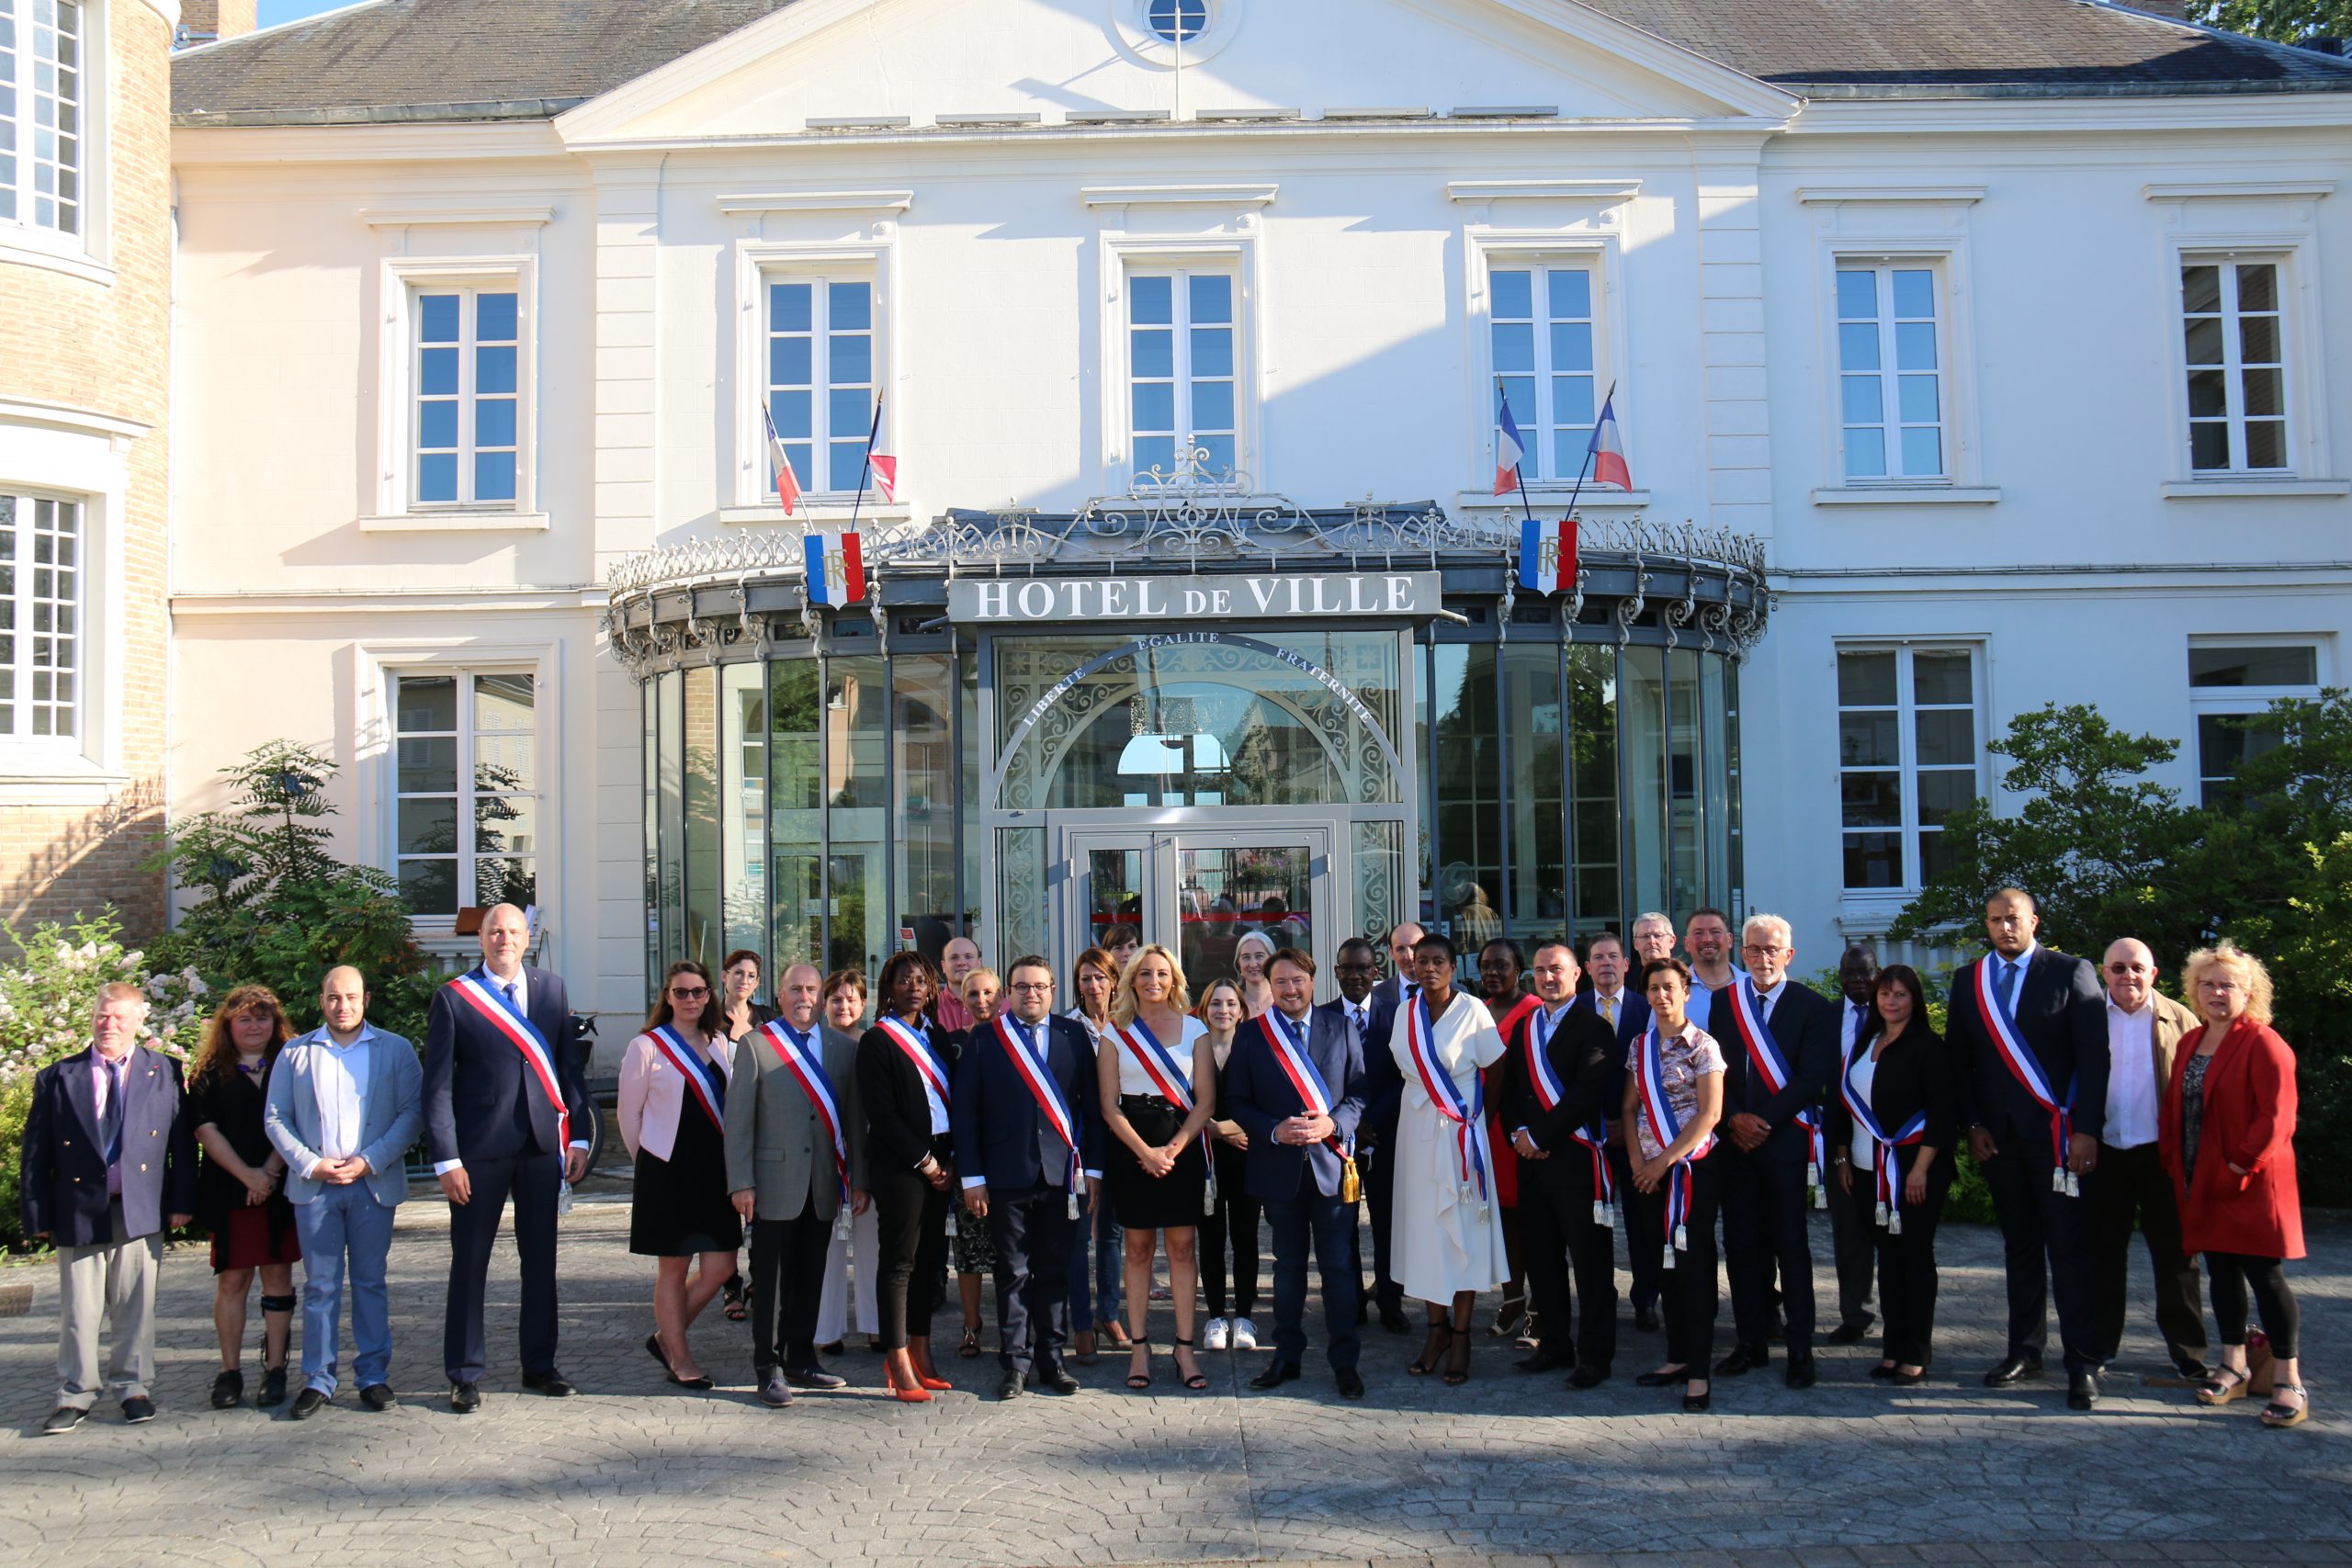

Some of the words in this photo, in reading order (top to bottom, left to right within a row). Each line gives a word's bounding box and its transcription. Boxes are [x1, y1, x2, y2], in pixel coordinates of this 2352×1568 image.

[974, 580, 1168, 618] HOTEL
[1183, 590, 1231, 615] DE
[1245, 576, 1415, 615] VILLE
[1023, 667, 1086, 727] LIBERTE
[1137, 632, 1220, 651] EGALITE
[1276, 648, 1372, 723] FRATERNITE
